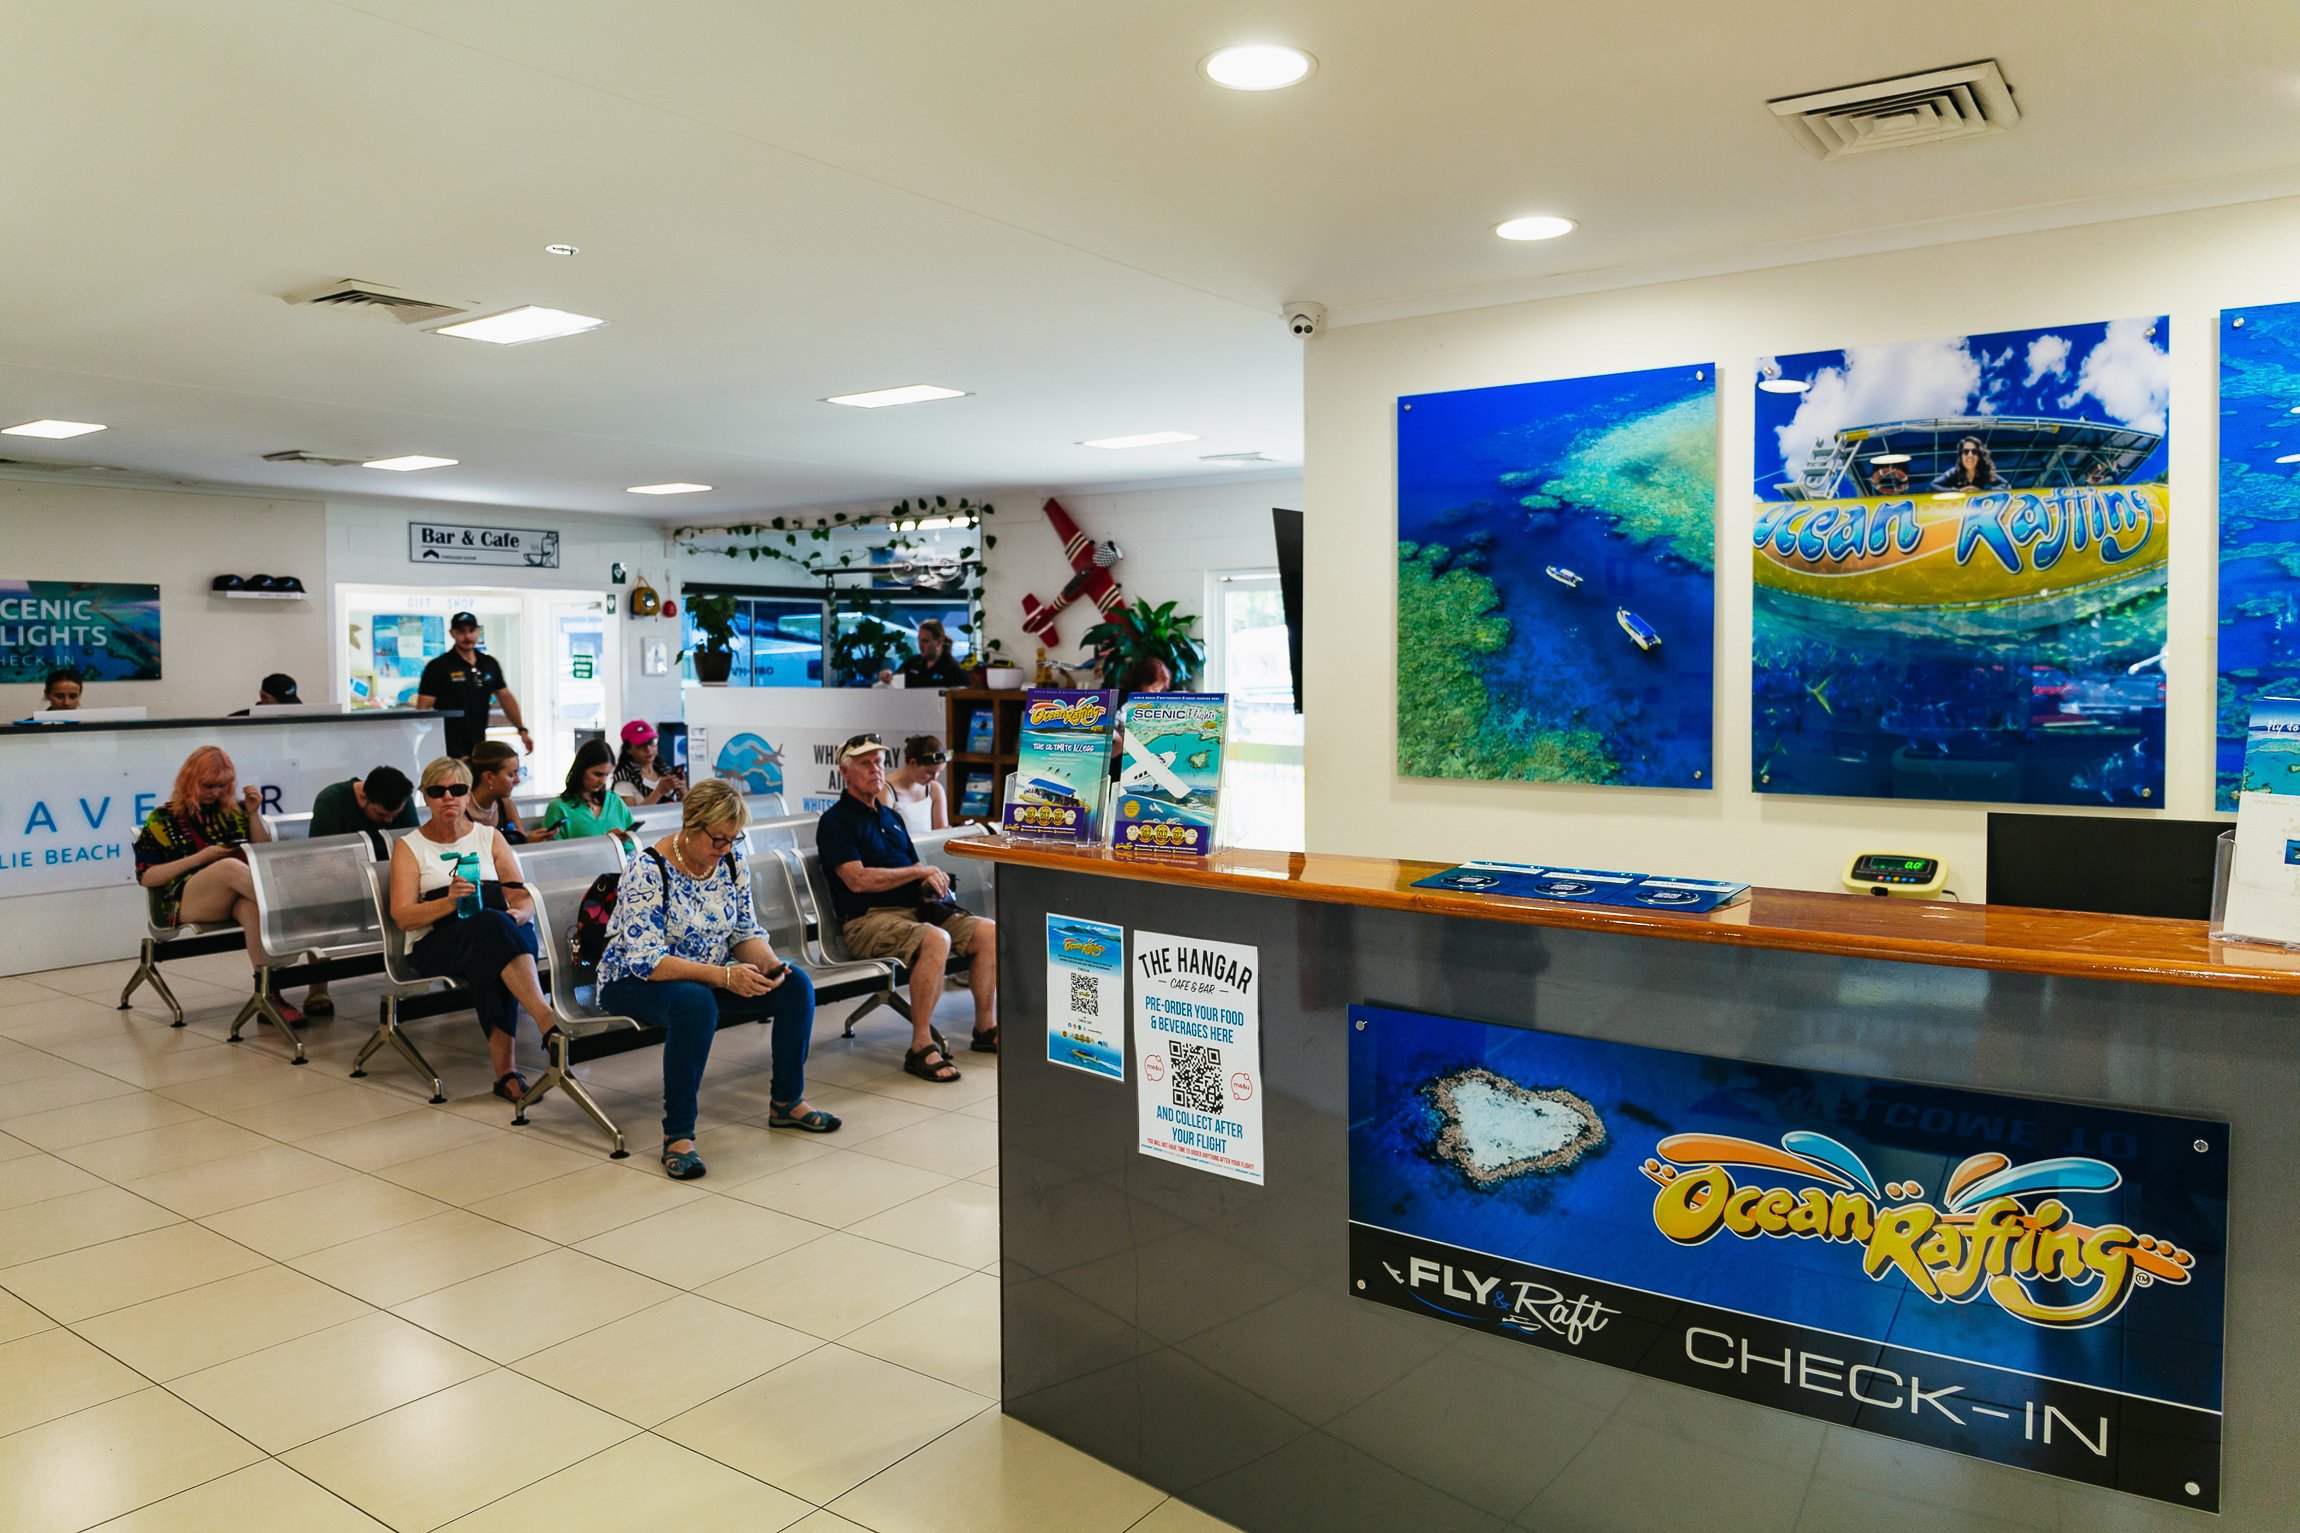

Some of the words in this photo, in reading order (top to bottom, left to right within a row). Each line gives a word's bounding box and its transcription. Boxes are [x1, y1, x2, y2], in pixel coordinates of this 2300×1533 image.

[421, 528, 455, 544] Bar
[462, 530, 474, 546] &
[481, 531, 520, 548] Cafe
[1753, 499, 1922, 562] Ocean
[1955, 486, 2154, 574] Rafting
[407, 597, 431, 609] GIFT
[447, 597, 474, 609] SHOP
[0, 625, 108, 646] LIGHTS
[1134, 709, 1185, 719] SCENIC
[45, 843, 120, 865] BEACH
[1138, 948, 1172, 978] THE
[1178, 947, 1253, 994] HANGAR
[1170, 978, 1191, 991] CAFE
[1190, 982, 1198, 993] &
[1198, 982, 1216, 994] BAR
[1145, 996, 1193, 1017] PRE-ORDER
[1194, 1004, 1218, 1022] YOUR
[1220, 1009, 1244, 1026] FOOD
[1151, 1015, 1157, 1029] &
[1159, 1016, 1208, 1039] BEVERAGES
[1210, 1025, 1234, 1044] HERE
[1156, 1105, 1174, 1122] AND
[1175, 1109, 1213, 1131] COLLECT
[1215, 1119, 1243, 1139] AFTER
[1172, 1127, 1195, 1146] YOUR
[1196, 1133, 1227, 1154] FLIGHT
[1654, 1166, 1876, 1246] Ocean
[1864, 1197, 2141, 1328] Rafting
[1410, 1256, 1501, 1305] FLY
[1493, 1290, 1512, 1311] &
[1510, 1281, 1622, 1345] Raft
[1685, 1326, 2108, 1457] CHECK-IN
